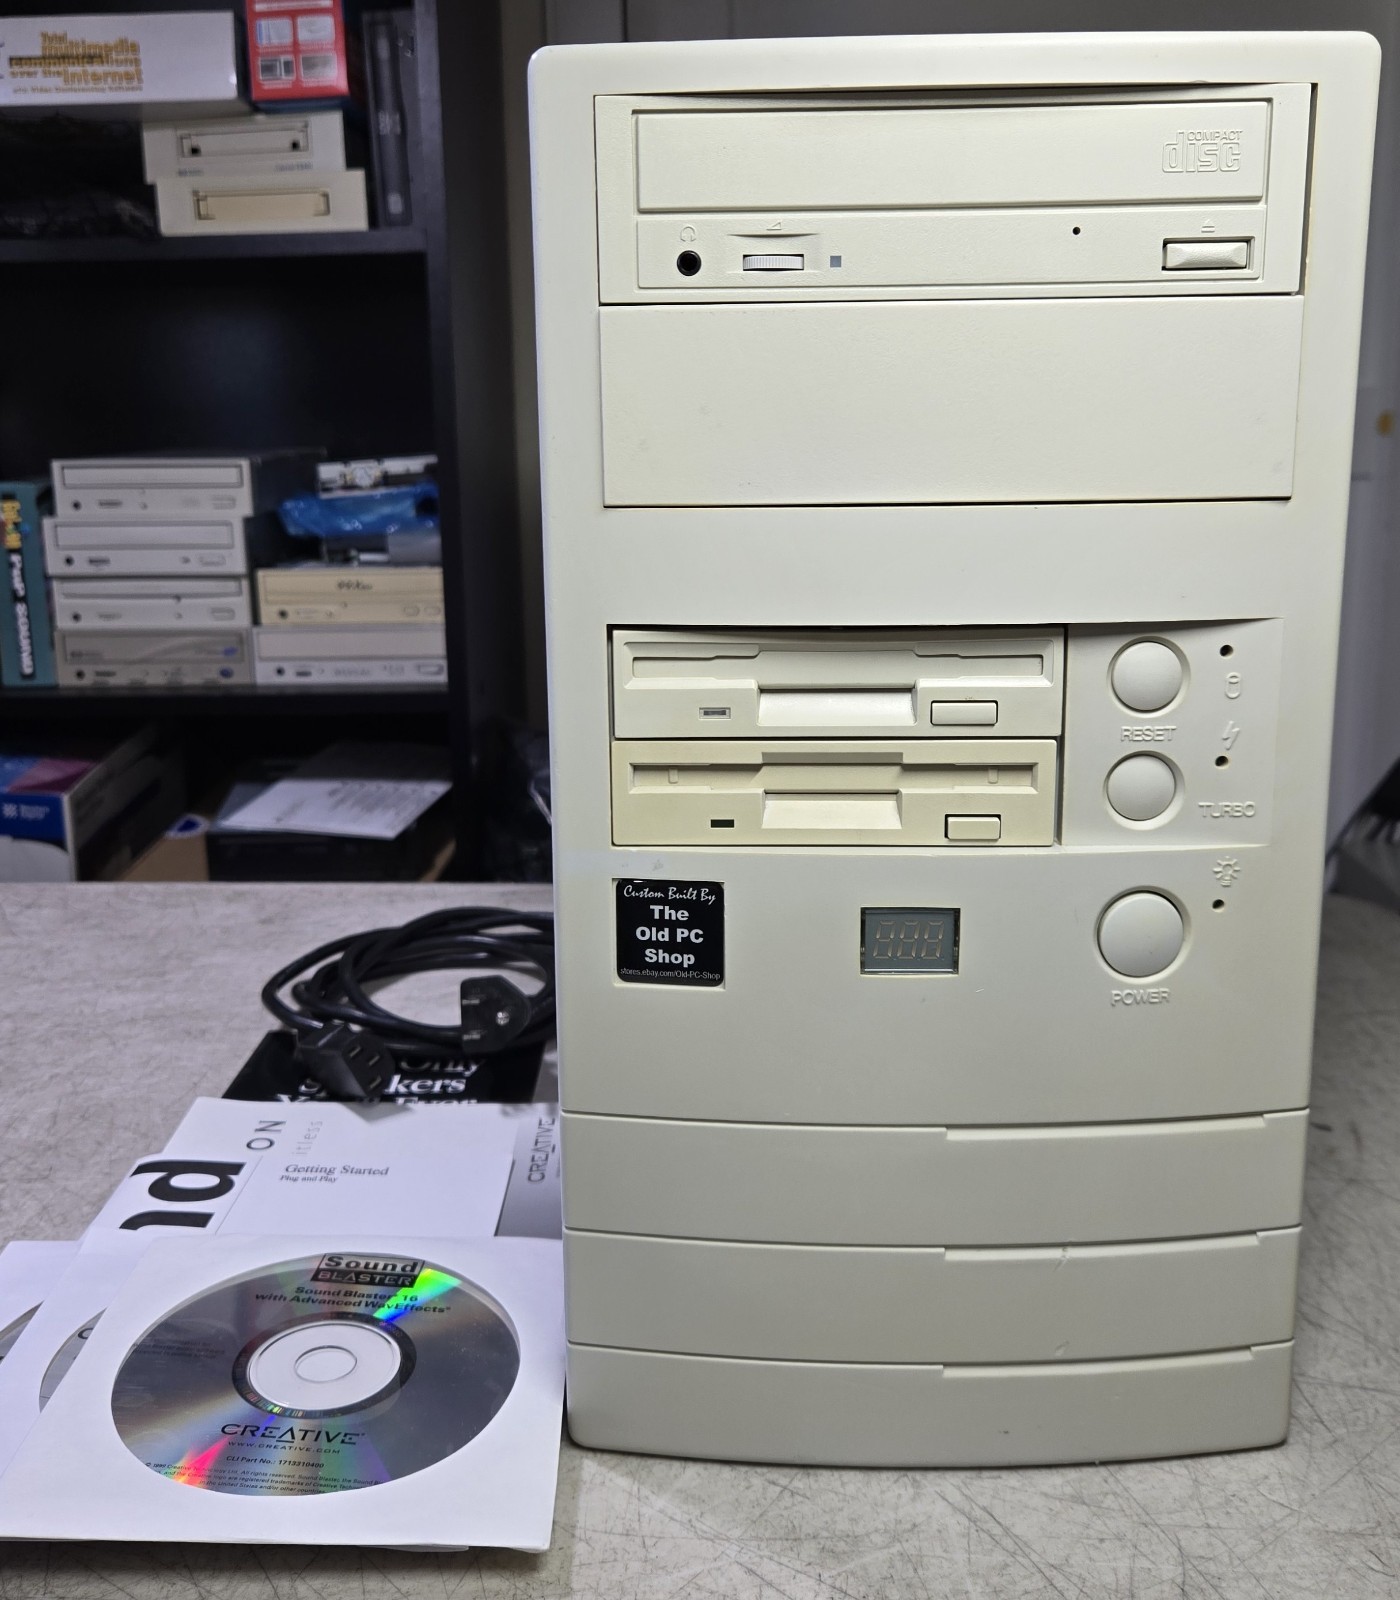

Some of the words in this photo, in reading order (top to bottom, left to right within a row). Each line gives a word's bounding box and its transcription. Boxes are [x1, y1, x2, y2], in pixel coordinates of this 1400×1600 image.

[1187, 131, 1243, 141] COMPACT
[1162, 131, 1241, 173] disc
[1120, 726, 1177, 742] RESET
[1198, 802, 1255, 818] TURBO
[624, 885, 664, 898] Custom
[668, 886, 697, 900] Built
[700, 888, 716, 905] By
[650, 905, 689, 920] The
[636, 926, 669, 942] Old
[676, 928, 704, 943] PC
[644, 948, 695, 968] Shop
[620, 967, 720, 980] stores.ebay.com/Old-PC-Shop
[1111, 988, 1170, 1007] POWER
[527, 1117, 556, 1182] CREATIVE
[285, 1164, 336, 1176] Getting
[340, 1165, 389, 1176] Started
[320, 1175, 338, 1183] Play
[325, 1256, 418, 1273] Sound
[318, 1271, 413, 1286] BLASTER
[290, 1296, 361, 1308] Advanced
[295, 1286, 341, 1297] Sound
[402, 1294, 418, 1302] 16
[221, 1423, 361, 1446] CREATIVE
[228, 1440, 340, 1454] WWW.CREATIVE.COM
[240, 1456, 259, 1464] Part
